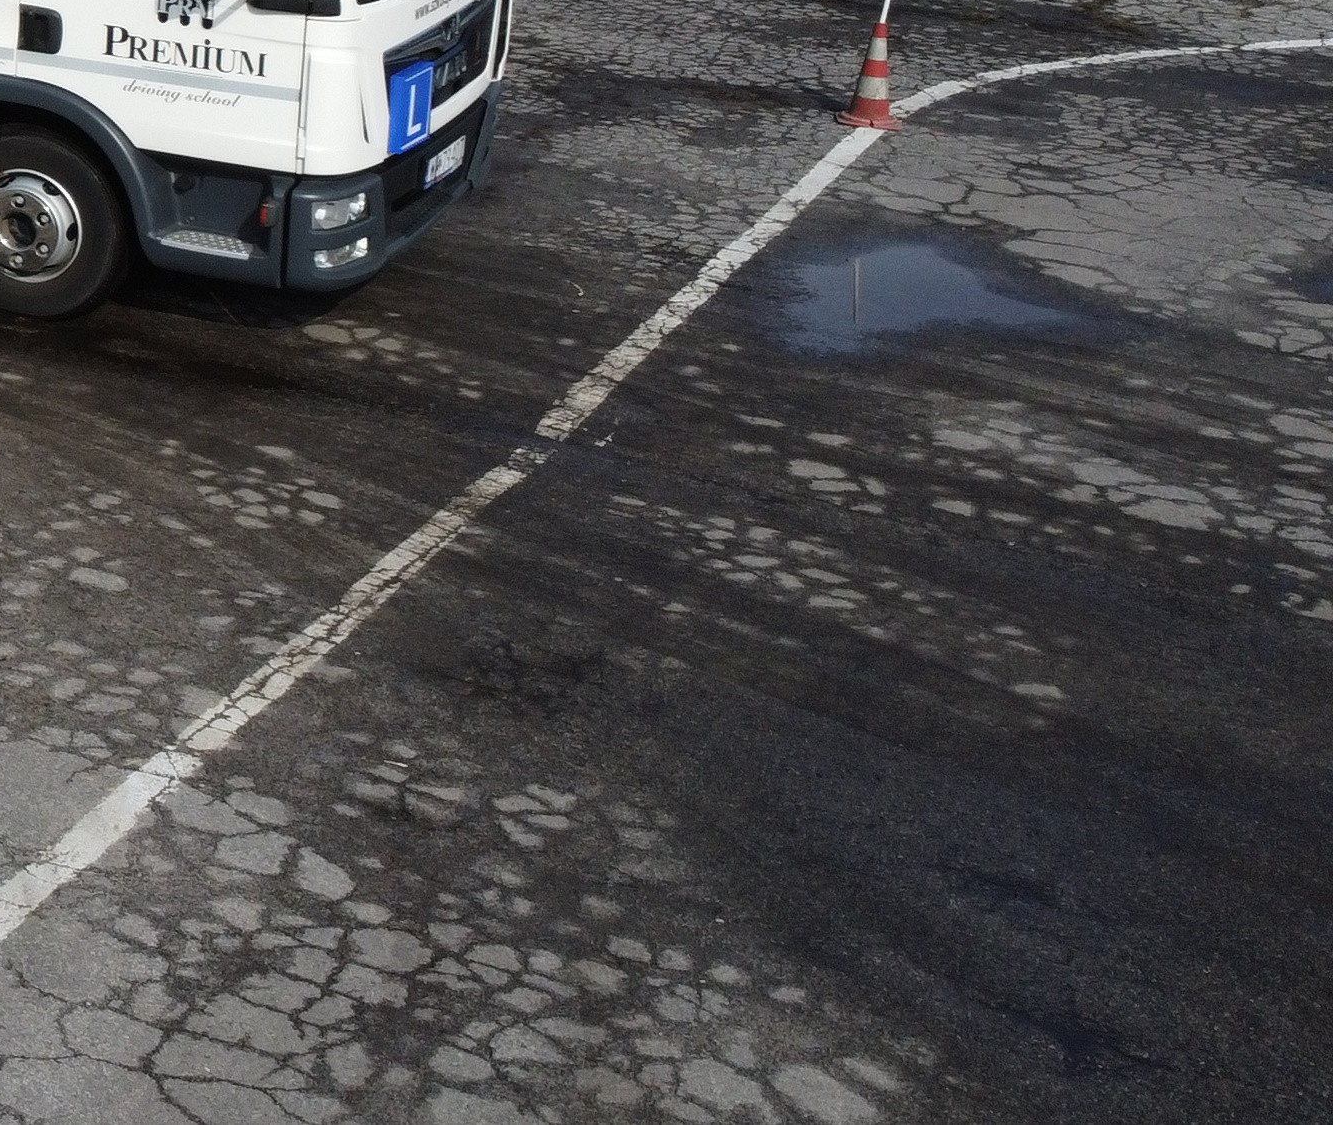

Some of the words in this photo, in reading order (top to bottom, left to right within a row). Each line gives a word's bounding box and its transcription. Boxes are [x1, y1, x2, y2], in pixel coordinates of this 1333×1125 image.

[123, 79, 181, 104] driving
[186, 91, 242, 108] school
[407, 84, 422, 137] L
